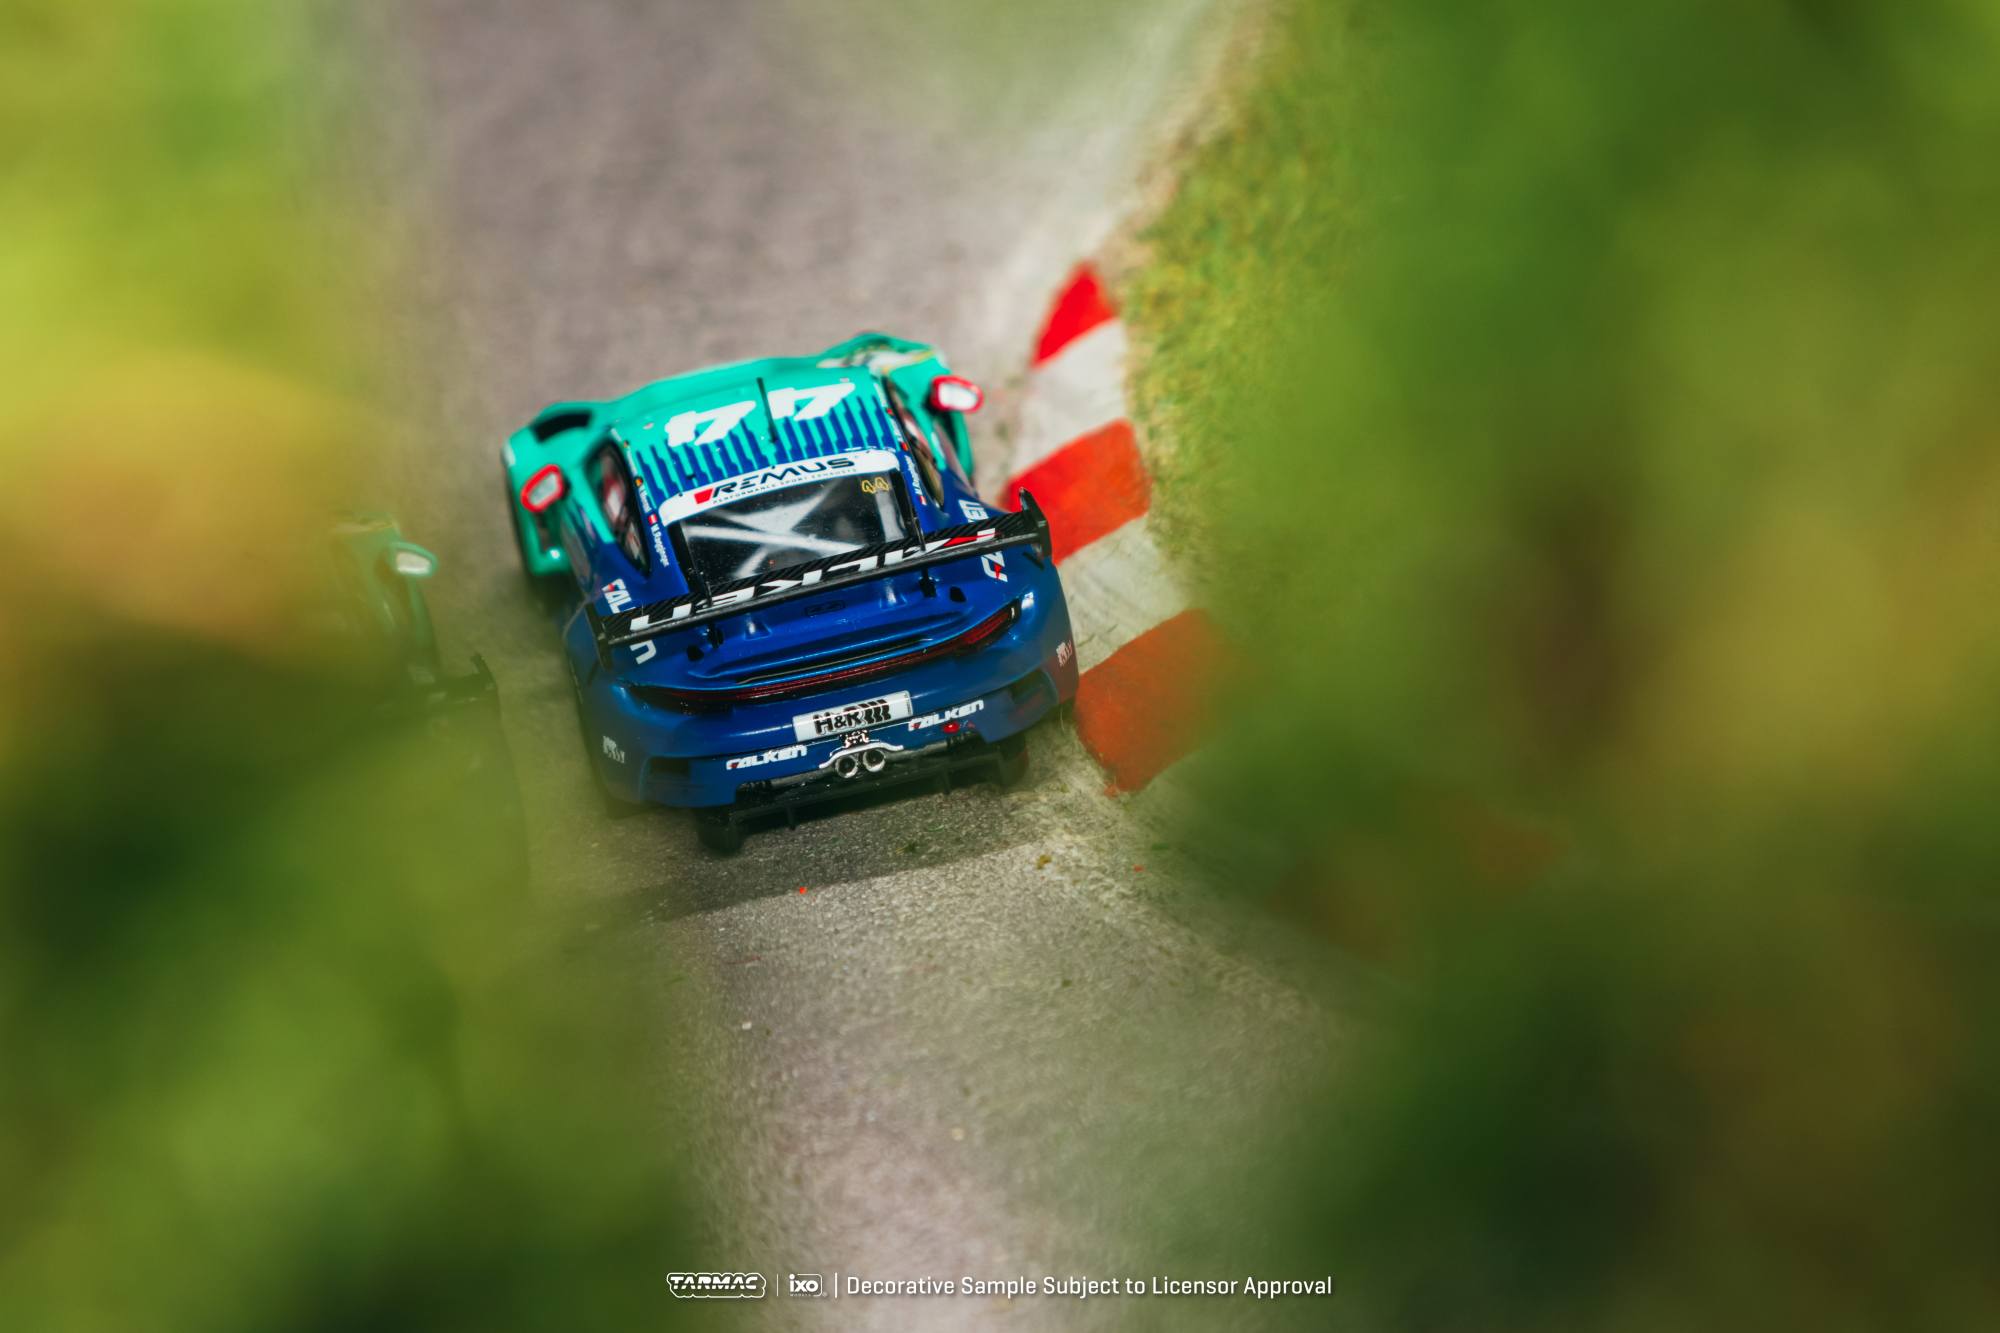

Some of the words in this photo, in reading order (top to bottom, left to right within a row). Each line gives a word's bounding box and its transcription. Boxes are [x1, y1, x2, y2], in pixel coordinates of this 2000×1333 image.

[713, 457, 855, 498] REMUS
[908, 699, 985, 732] FALKEN
[725, 744, 808, 771] FALKEN
